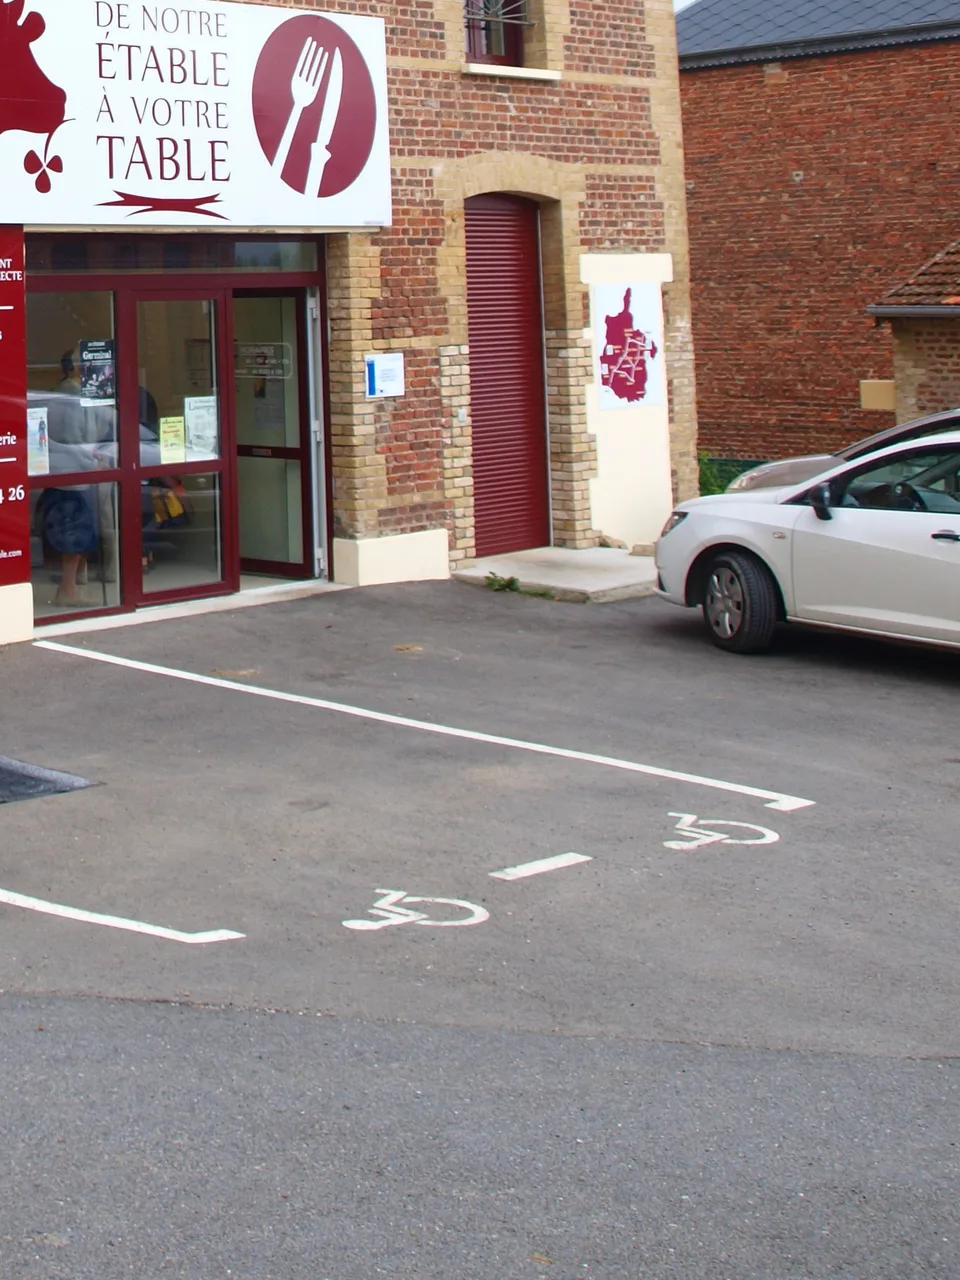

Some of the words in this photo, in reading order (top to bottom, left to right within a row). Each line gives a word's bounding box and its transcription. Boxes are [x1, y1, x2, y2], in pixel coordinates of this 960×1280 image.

[96, 1, 129, 29] DE
[141, 5, 228, 37] NOTRE
[95, 31, 229, 87] ÉTABLE
[95, 85, 114, 123] À
[131, 97, 227, 128] VOTRE
[96, 135, 231, 181] TABLE
[9, 485, 24, 500] 26
